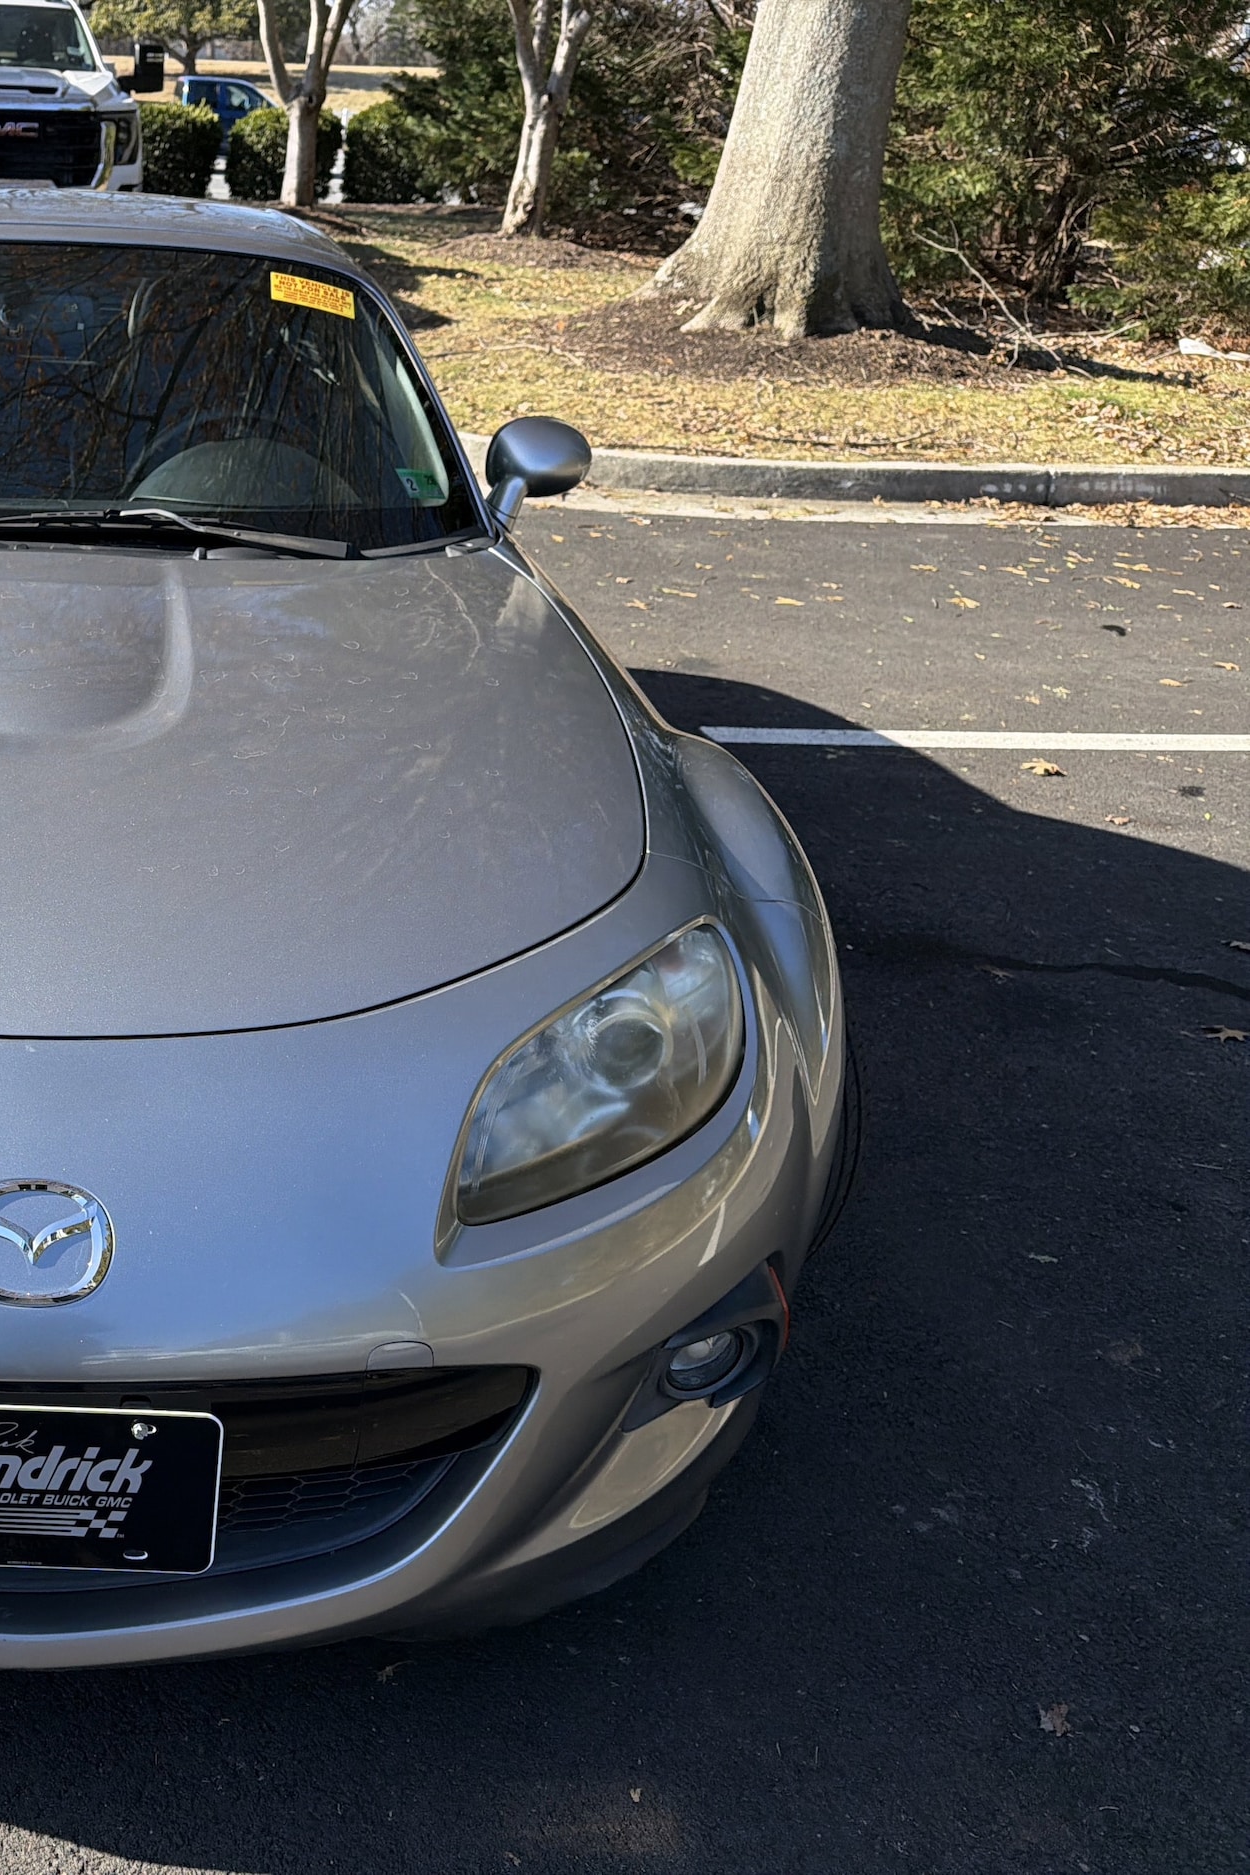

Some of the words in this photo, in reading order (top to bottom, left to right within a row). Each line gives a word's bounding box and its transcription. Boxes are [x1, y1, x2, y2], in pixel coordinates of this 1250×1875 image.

[300, 280, 338, 292] VEHICLE
[302, 285, 320, 293] FOR
[323, 290, 346, 300] SALE
[406, 477, 417, 491] 2
[42, 1494, 91, 1507] BUICK
[95, 1496, 133, 1508] GMC
